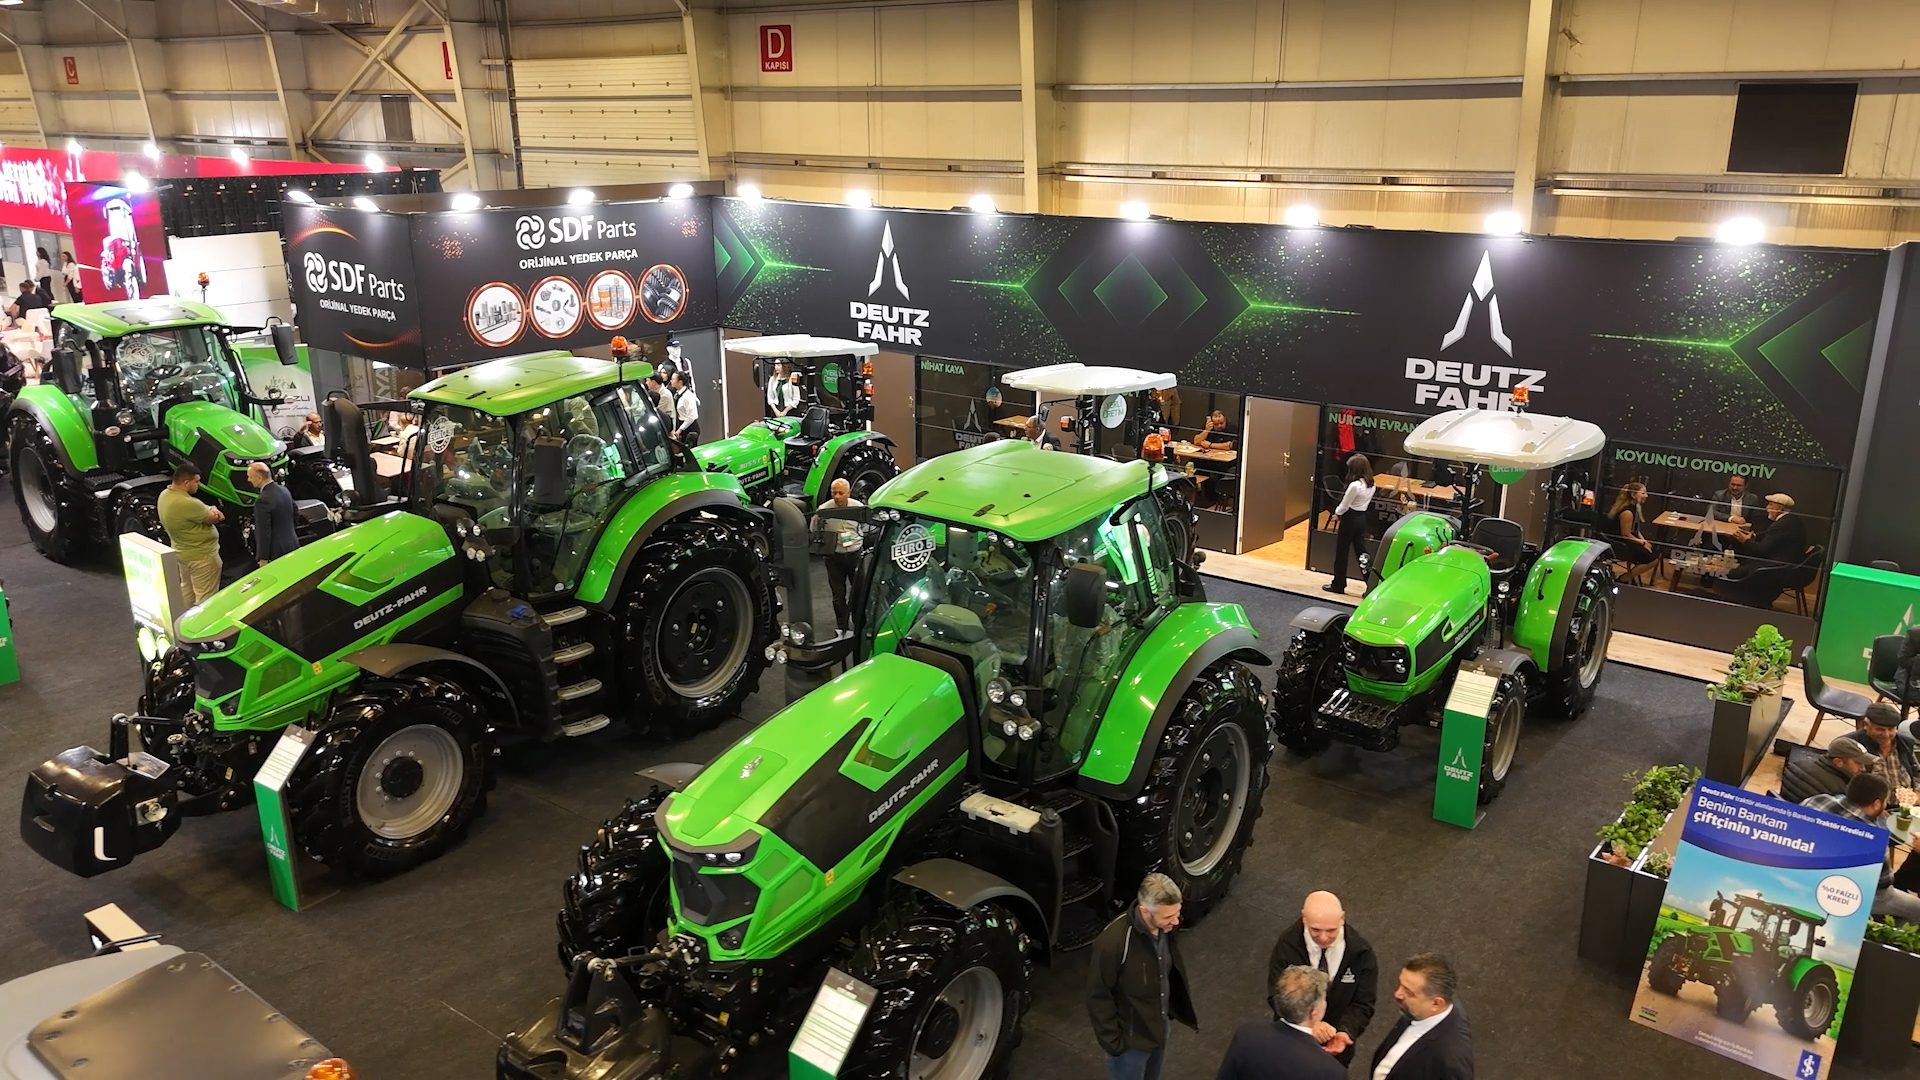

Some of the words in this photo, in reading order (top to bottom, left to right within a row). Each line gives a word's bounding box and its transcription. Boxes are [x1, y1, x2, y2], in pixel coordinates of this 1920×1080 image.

[767, 28, 785, 58] D
[765, 61, 789, 70] KAPISI
[549, 215, 594, 244] SDF
[597, 220, 637, 239] Parts
[519, 256, 567, 270] ORİJİNAL
[569, 252, 603, 265] YEDEK
[605, 248, 638, 261] PARÇA
[328, 260, 366, 295] SDF
[368, 273, 406, 302] Parts
[349, 304, 372, 317] YEDEK
[372, 309, 397, 323] PARÇA
[849, 301, 930, 328] DEUTZ
[857, 321, 923, 347] FAHR
[920, 360, 944, 373] NİHAT
[944, 364, 965, 375] KAYA
[1404, 357, 1547, 393] DEUTZ
[1329, 412, 1378, 430] NURCAN
[1615, 448, 1689, 470] KOYUNCU
[1690, 457, 1777, 480] OTOMOTİV
[894, 543, 924, 557] EURO
[926, 540, 933, 549] 5
[353, 585, 428, 630] DEUTZ-FAHR
[1443, 765, 1473, 778] DEUTZ
[868, 758, 939, 823] DEUTZ-FAHR
[1697, 795, 1736, 816] Benim
[1737, 807, 1788, 830] Bankam
[1693, 811, 1750, 835] çiftçinin
[1751, 826, 1816, 854] yanında!
[1827, 894, 1850, 905] KREDİ
